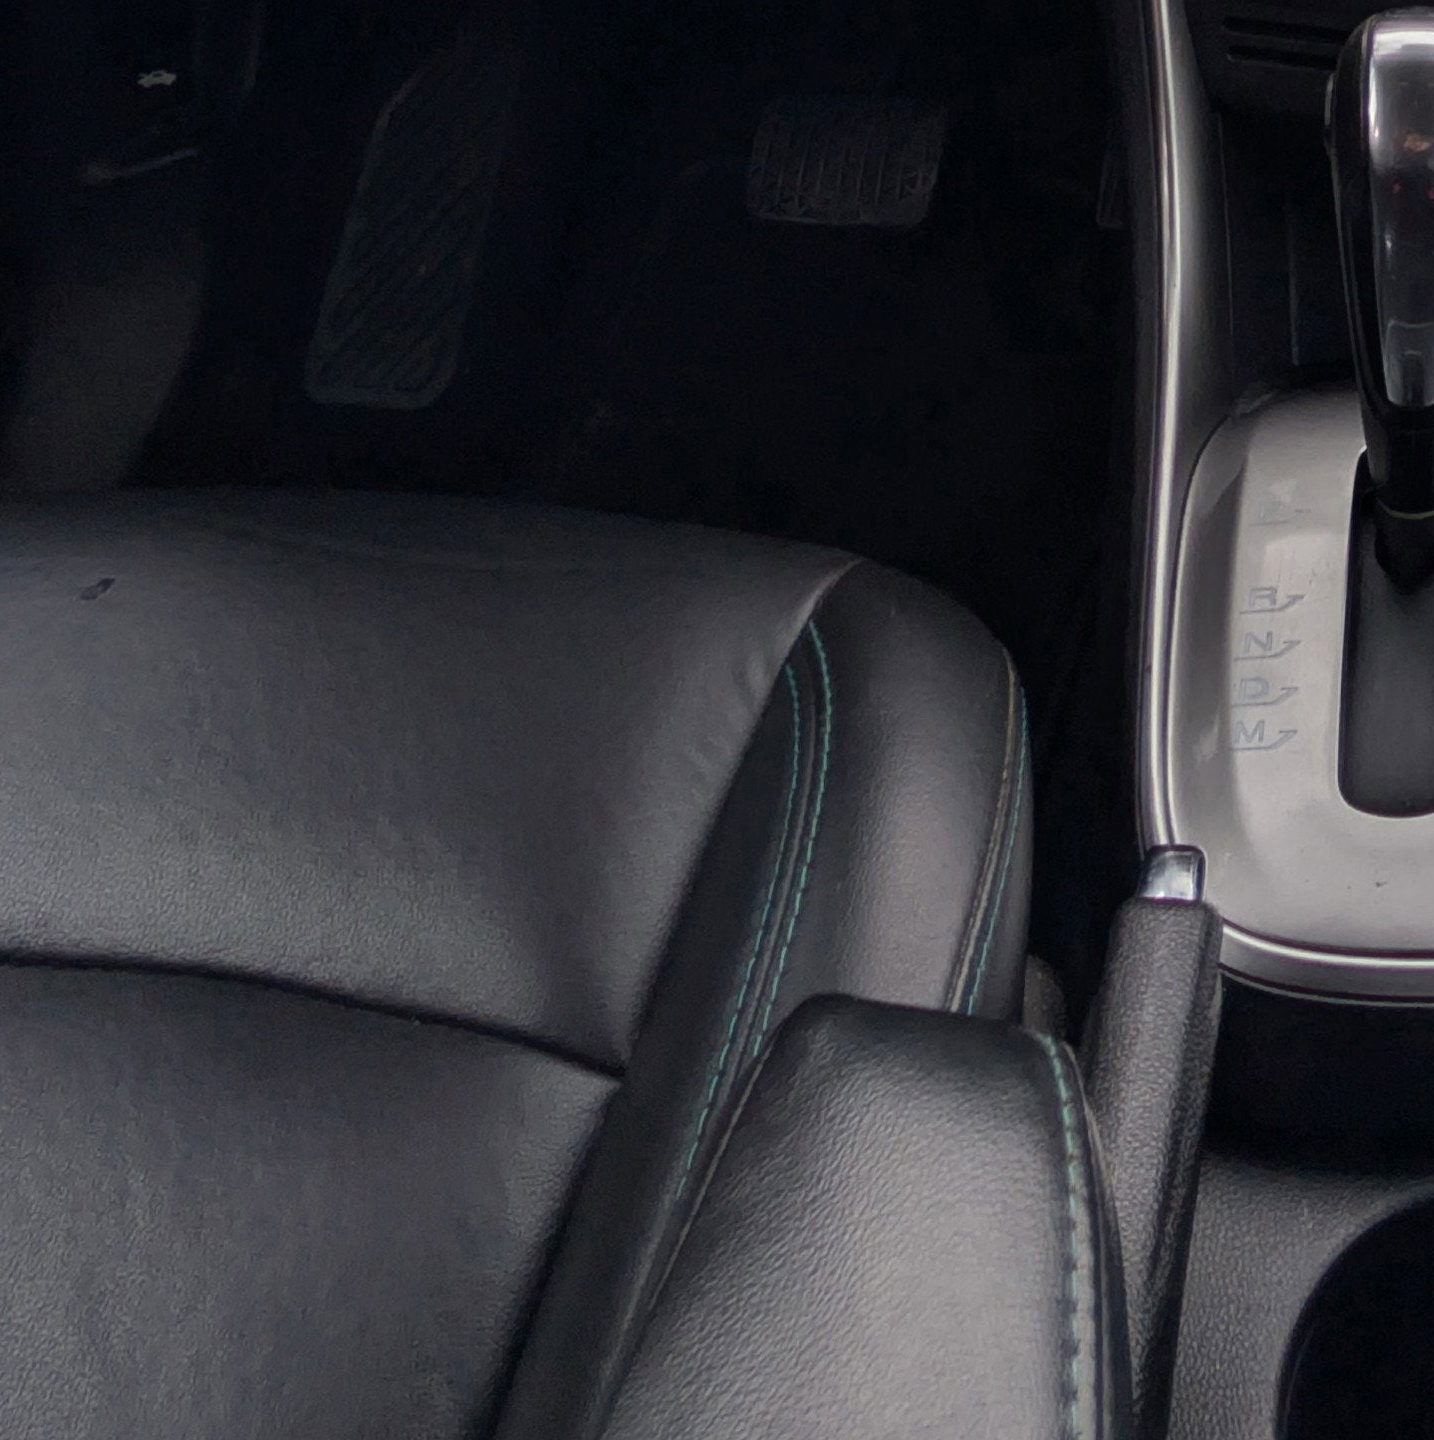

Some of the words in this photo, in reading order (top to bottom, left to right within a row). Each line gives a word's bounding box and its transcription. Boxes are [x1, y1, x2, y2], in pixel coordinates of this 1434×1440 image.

[1247, 587, 1278, 607] R
[1244, 631, 1275, 652] N
[1239, 676, 1271, 698] D
[1234, 719, 1265, 743] M
